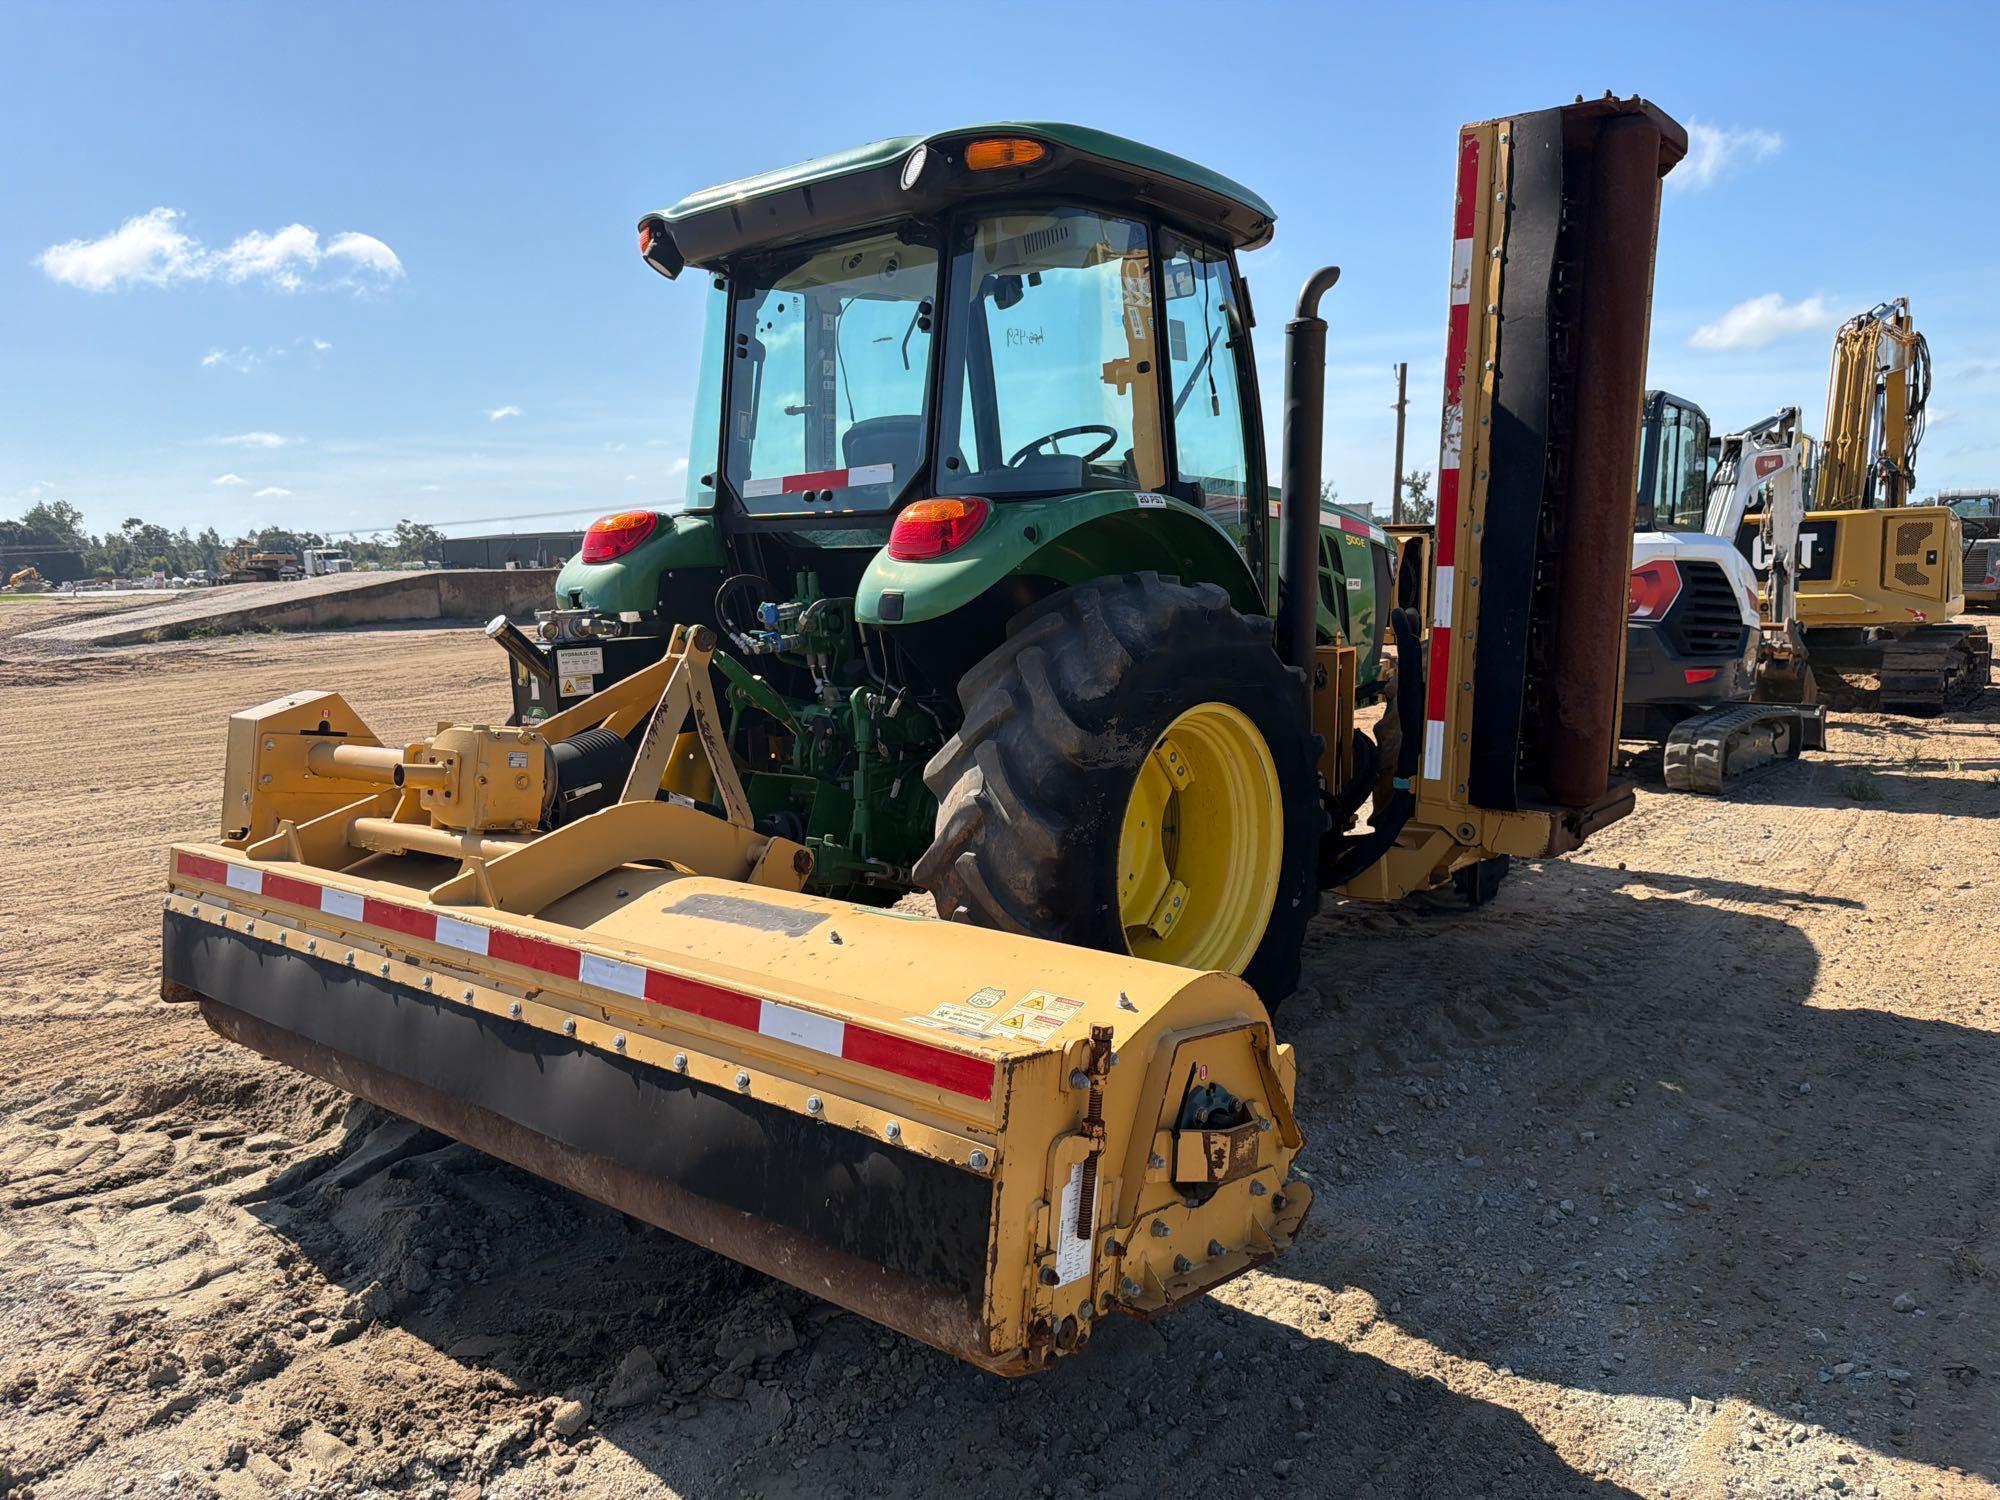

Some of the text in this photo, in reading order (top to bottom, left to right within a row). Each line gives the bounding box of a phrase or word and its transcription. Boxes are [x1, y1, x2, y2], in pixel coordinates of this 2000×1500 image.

[1150, 496, 1163, 504] PSI
[1752, 533, 1818, 570] CT
[522, 715, 546, 726] Diamo
[973, 996, 992, 1007] USA
